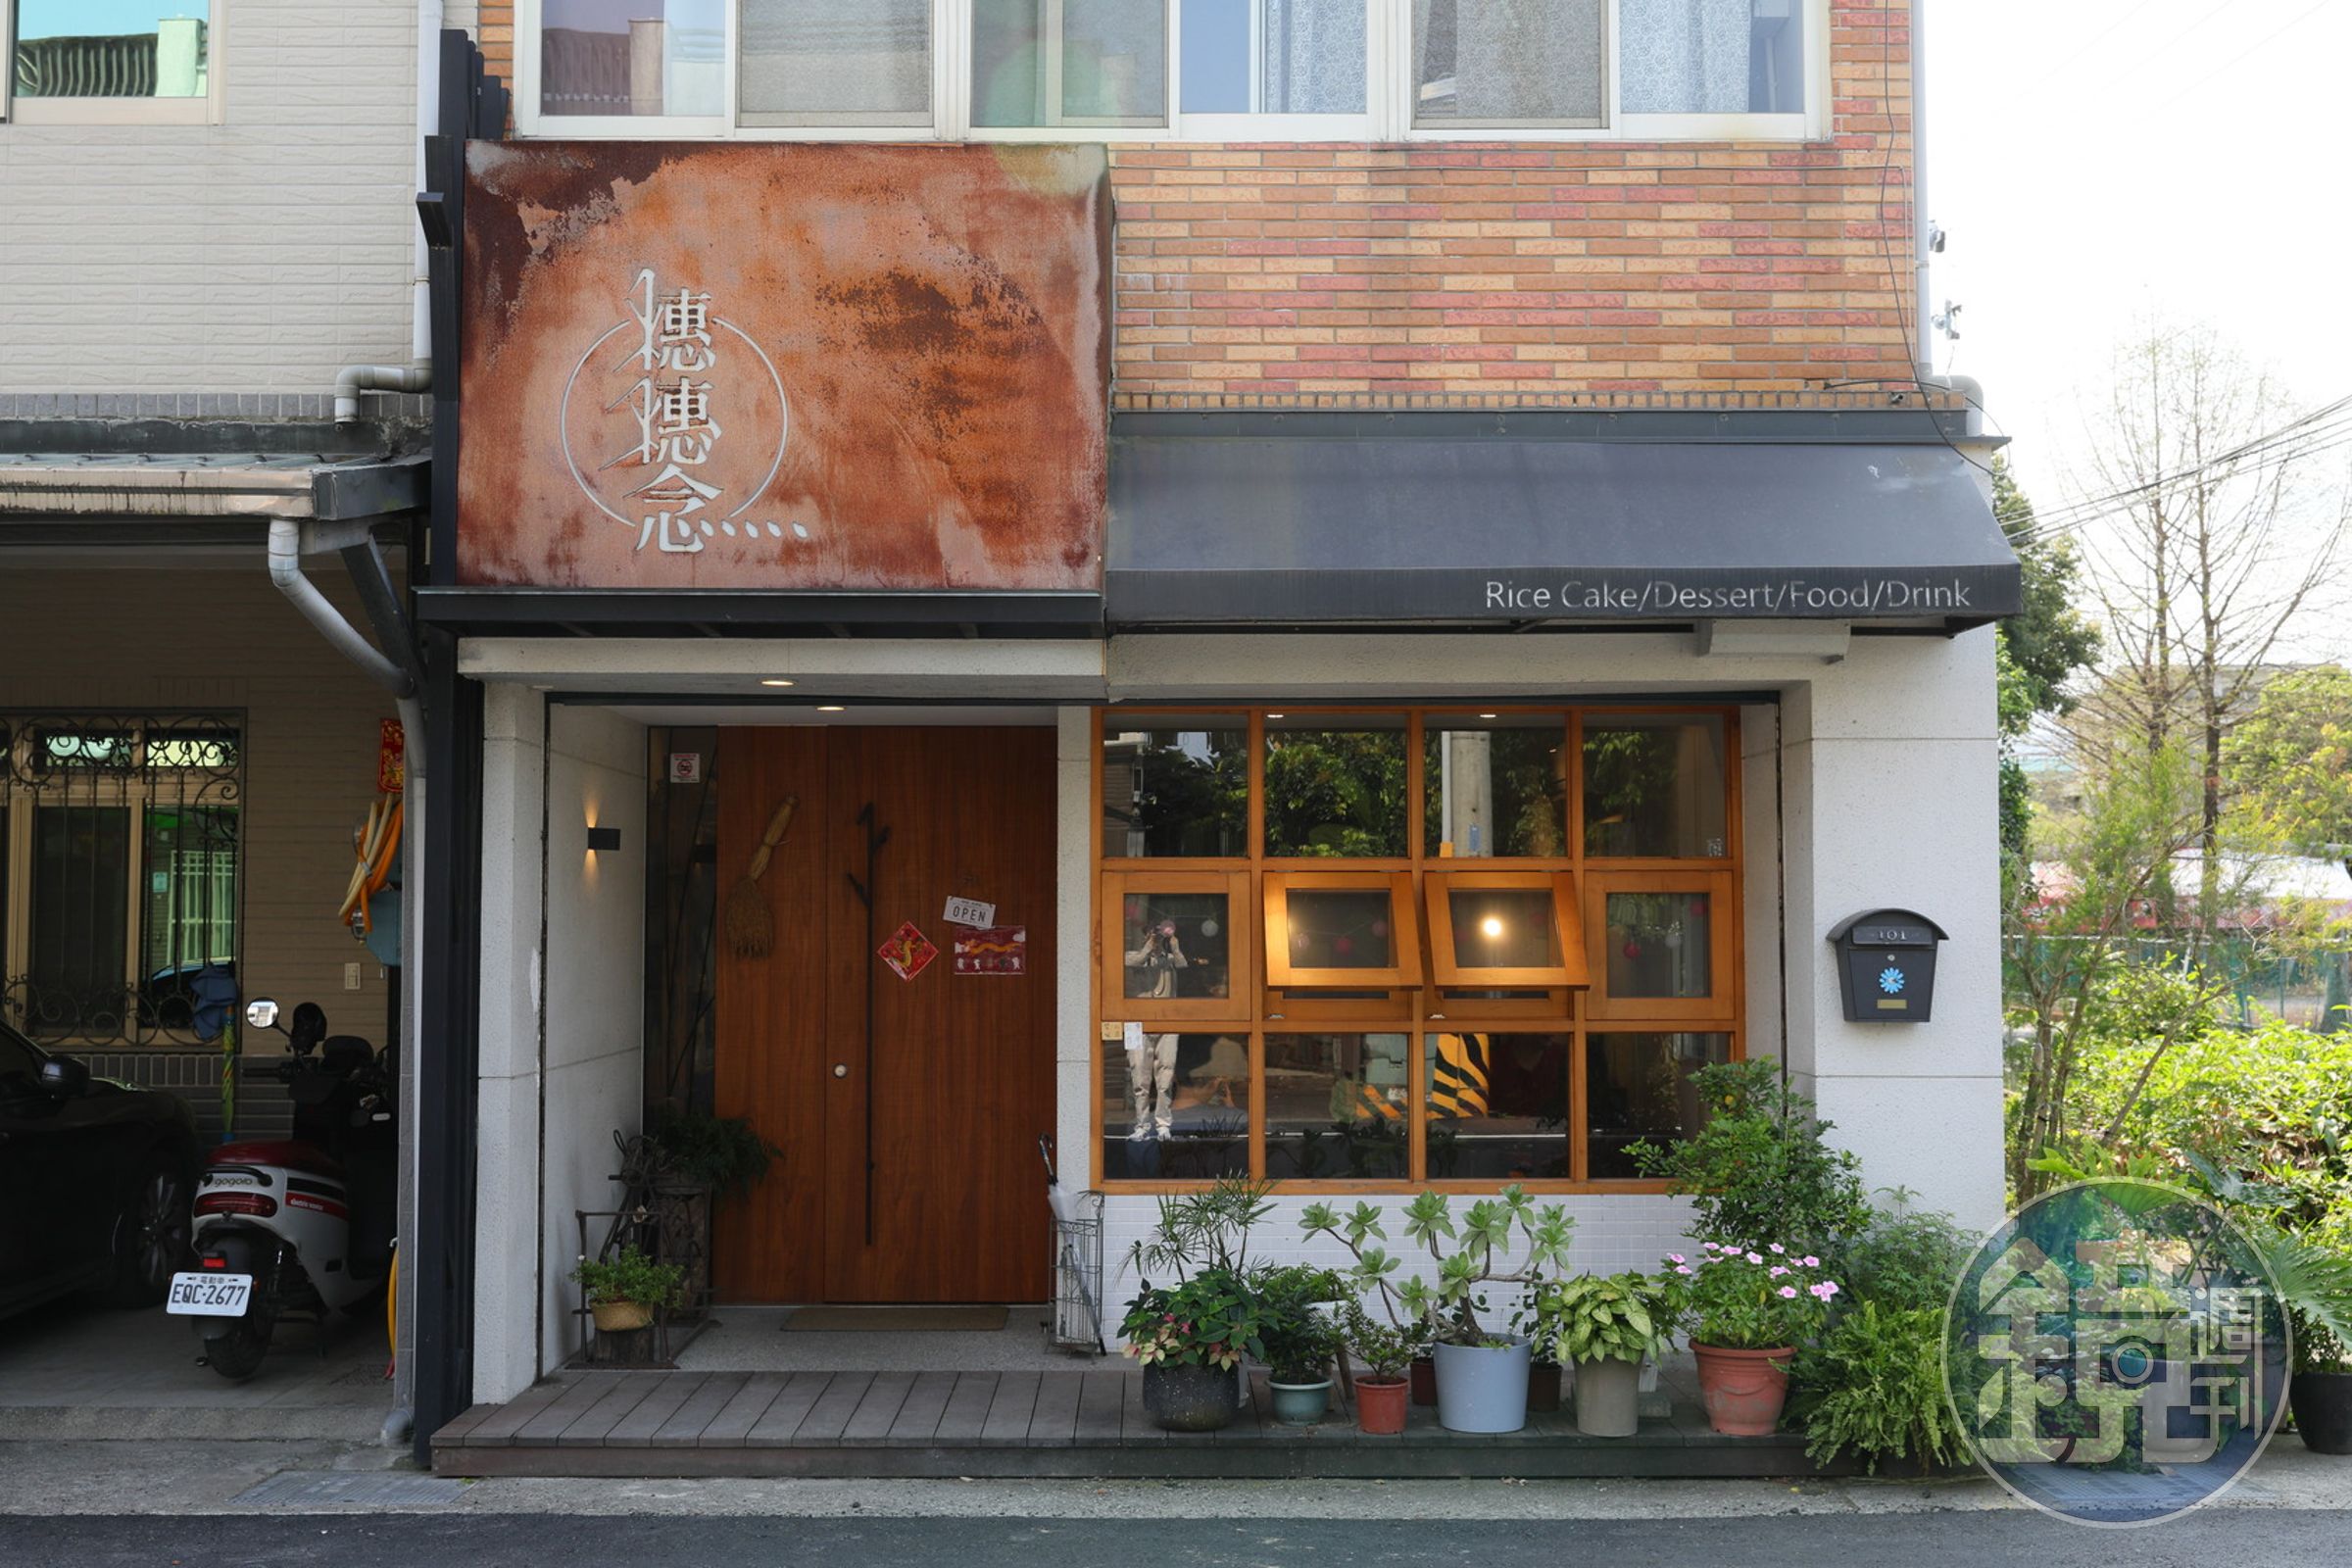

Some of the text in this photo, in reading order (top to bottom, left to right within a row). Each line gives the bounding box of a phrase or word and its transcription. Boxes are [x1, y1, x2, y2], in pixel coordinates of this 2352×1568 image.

[1485, 580, 1551, 609] Rice
[953, 905, 987, 922] OPEN
[1877, 930, 1908, 942] 101
